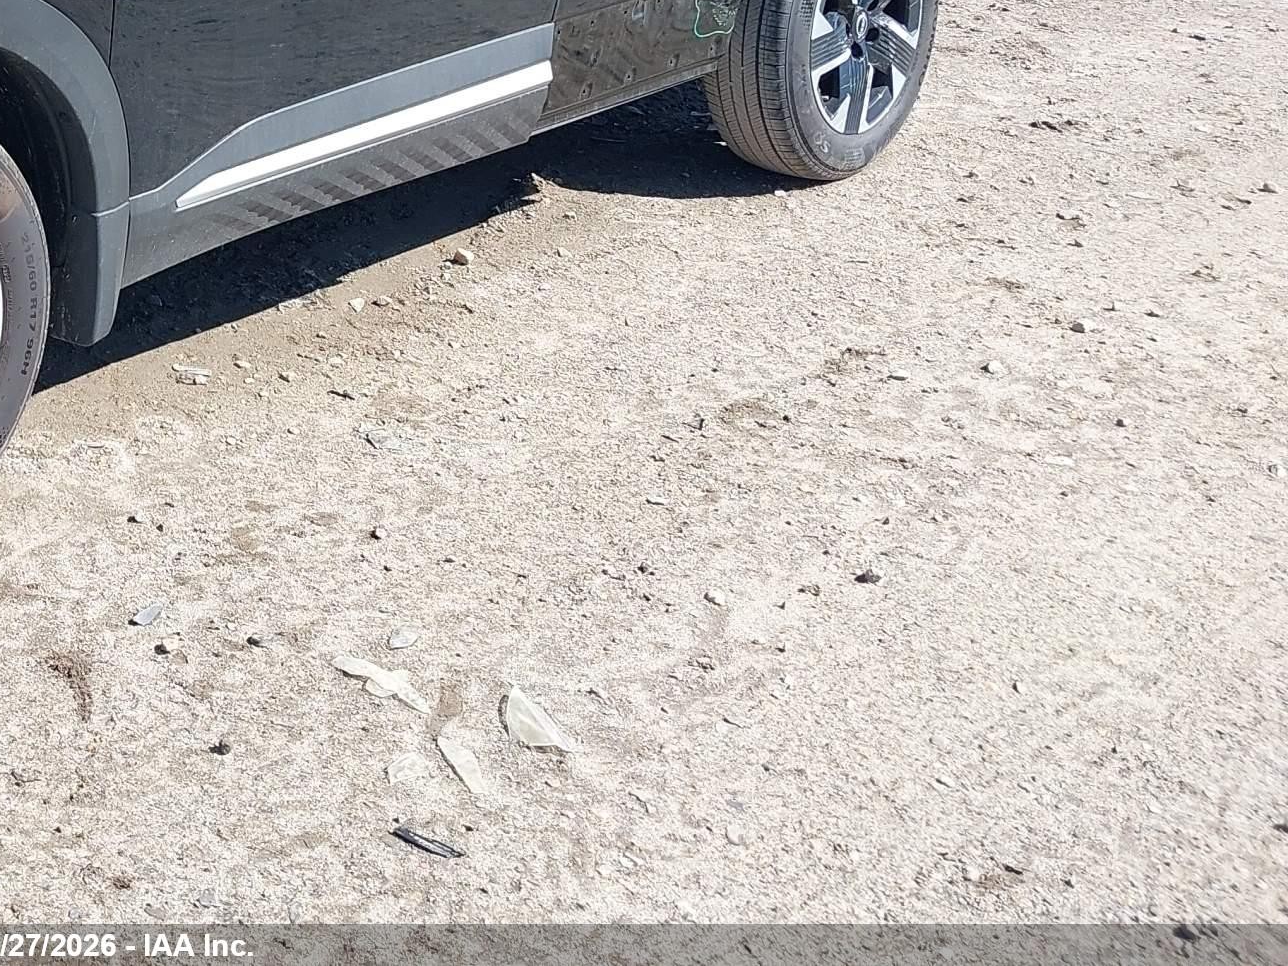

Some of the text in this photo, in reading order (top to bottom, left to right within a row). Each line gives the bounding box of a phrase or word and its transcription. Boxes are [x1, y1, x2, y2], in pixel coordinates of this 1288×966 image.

[20, 231, 39, 376] 215/60 R17 96H
